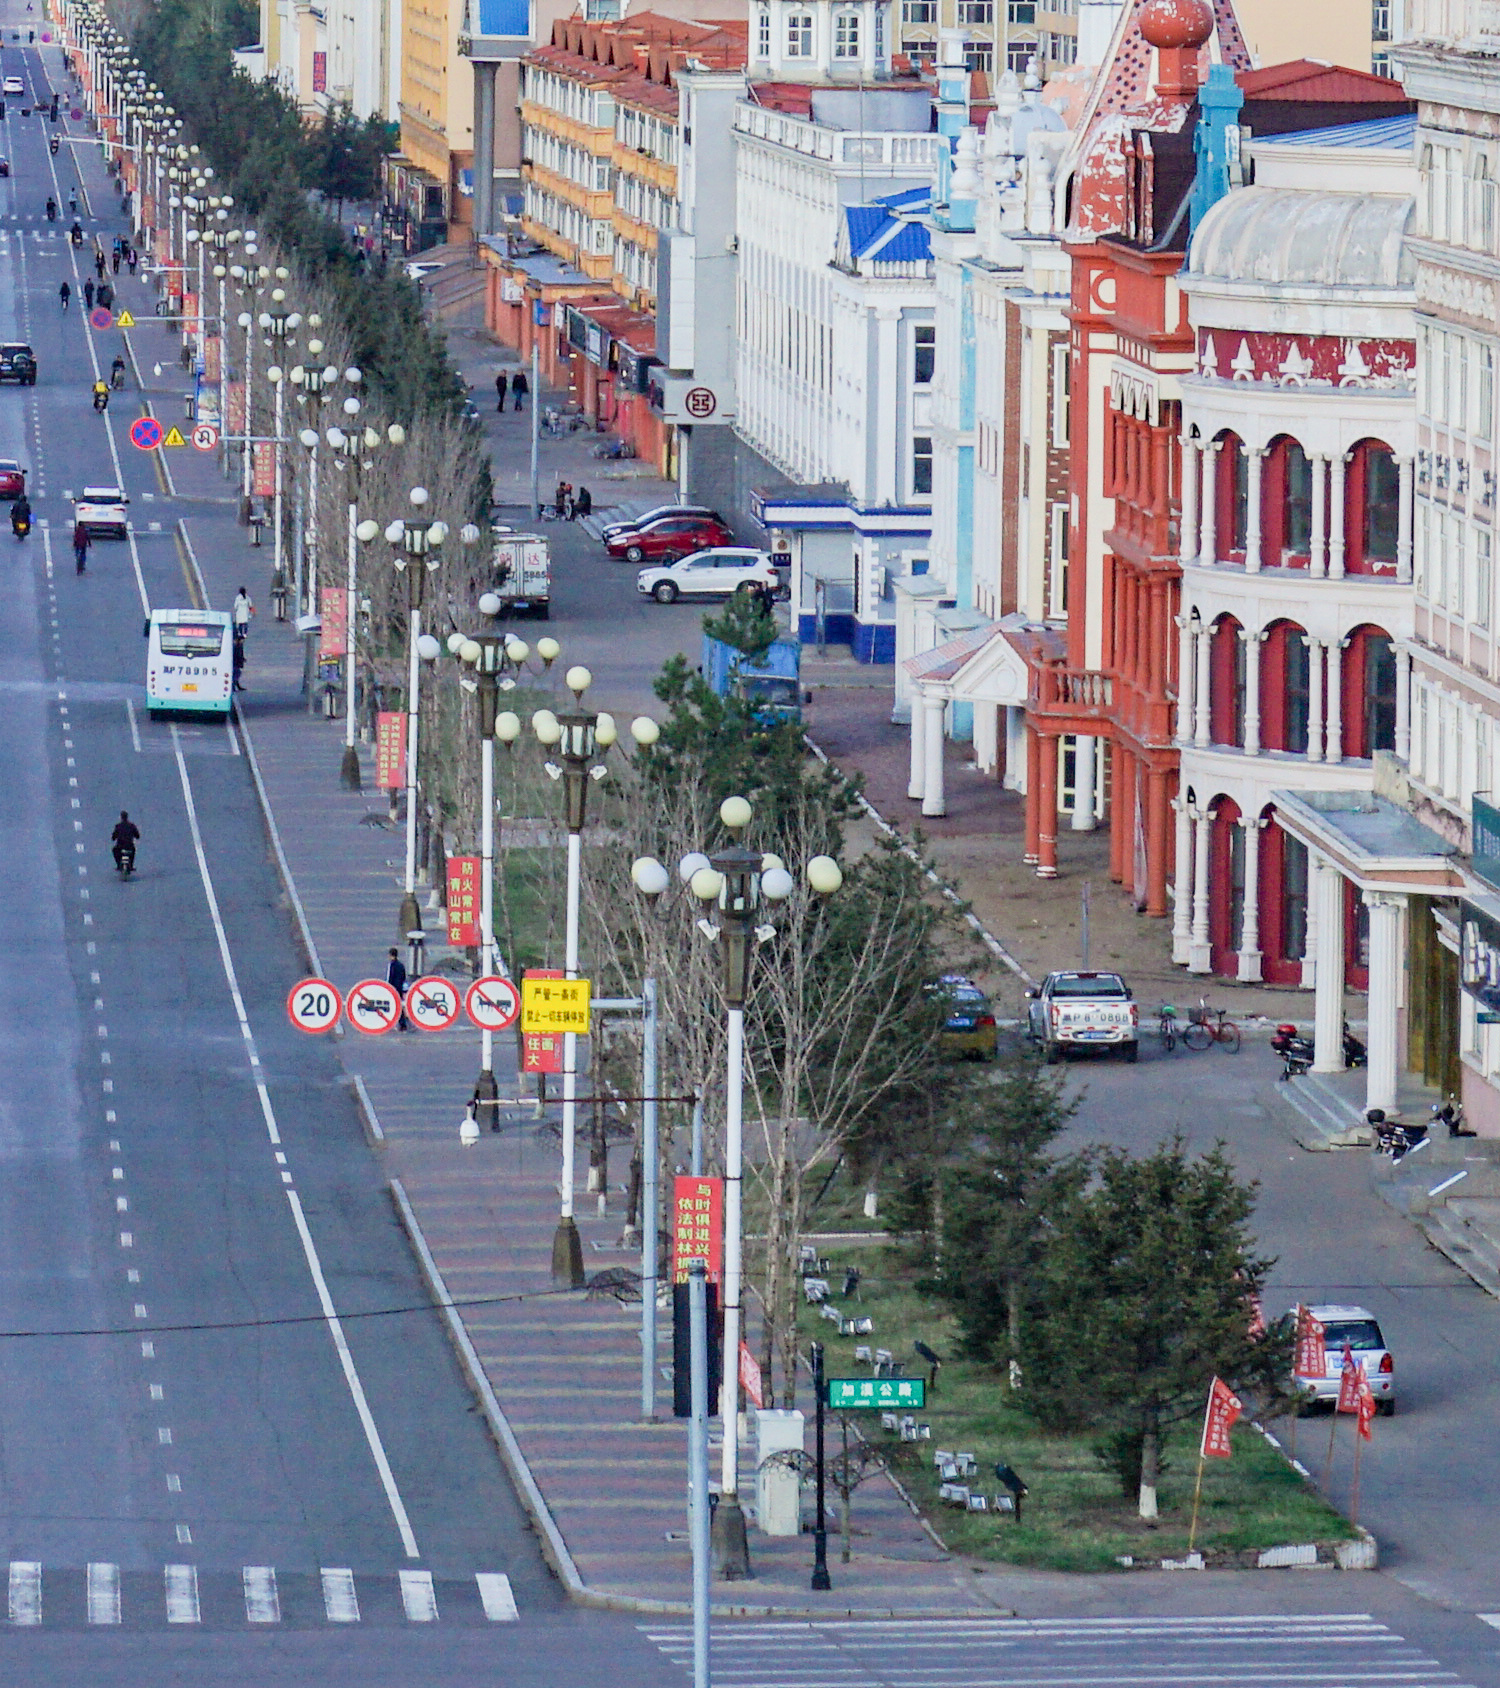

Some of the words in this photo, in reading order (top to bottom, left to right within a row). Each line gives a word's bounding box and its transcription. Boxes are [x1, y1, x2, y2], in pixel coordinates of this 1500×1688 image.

[533, 988, 579, 1002] 严管一条街
[300, 992, 330, 1017] 20
[527, 1010, 585, 1024] 禁止一切车辆停放
